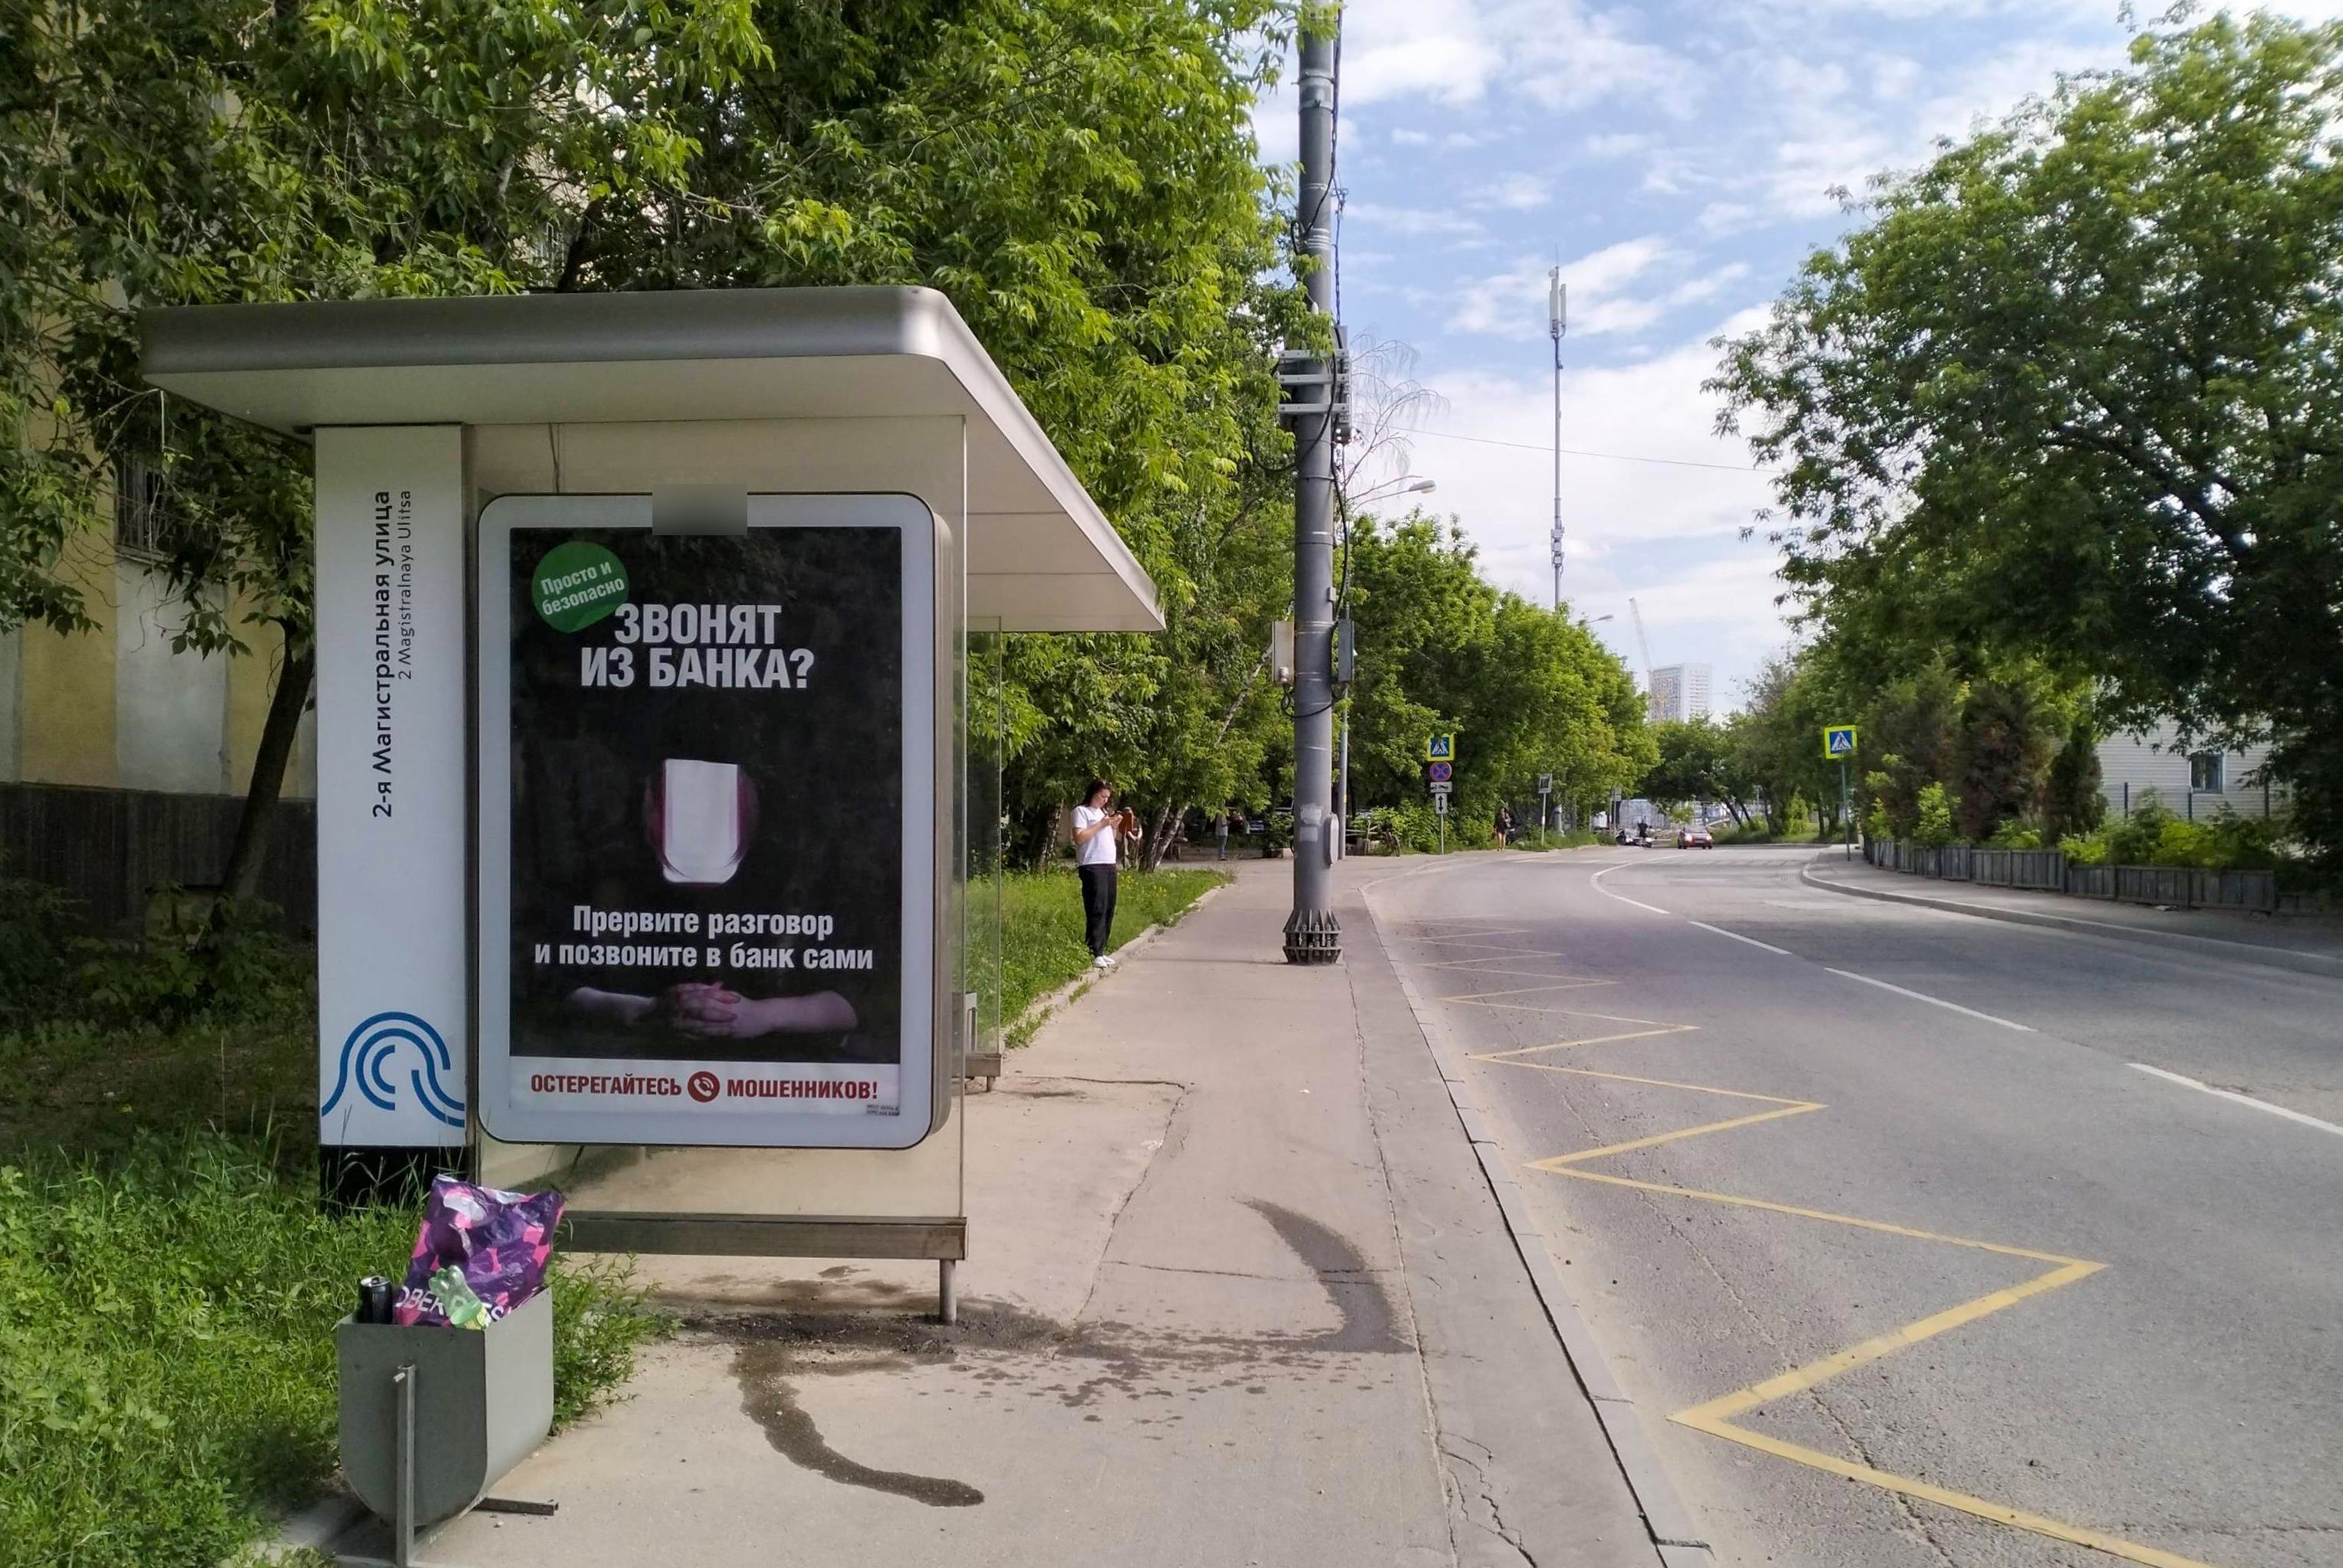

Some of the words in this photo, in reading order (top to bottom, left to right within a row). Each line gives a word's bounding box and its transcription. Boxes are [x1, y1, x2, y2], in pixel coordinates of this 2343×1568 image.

[374, 491, 395, 567] улица
[397, 491, 411, 539] Ulitsa
[541, 567, 597, 595] Просто
[600, 561, 612, 575] и
[542, 578, 625, 616] безопасно
[397, 544, 415, 665] Magistralnaya
[614, 603, 782, 645] ЗВОНЯТ
[372, 574, 395, 774] Магистральная
[397, 670, 412, 680] 2
[581, 646, 635, 688] ИЗ
[649, 647, 815, 688] БАНКА?
[372, 782, 392, 818] 2-я
[573, 905, 699, 938] Прервите
[708, 912, 833, 941] разговор
[534, 943, 551, 964] и
[559, 943, 698, 967] позвоните
[706, 947, 721, 967] в
[730, 941, 795, 969] банк
[803, 948, 873, 969] сами
[531, 1073, 682, 1096] ОСТЕРЕГАЙТЕСЬ
[727, 1079, 877, 1099] МОШЕННИКОВ!
